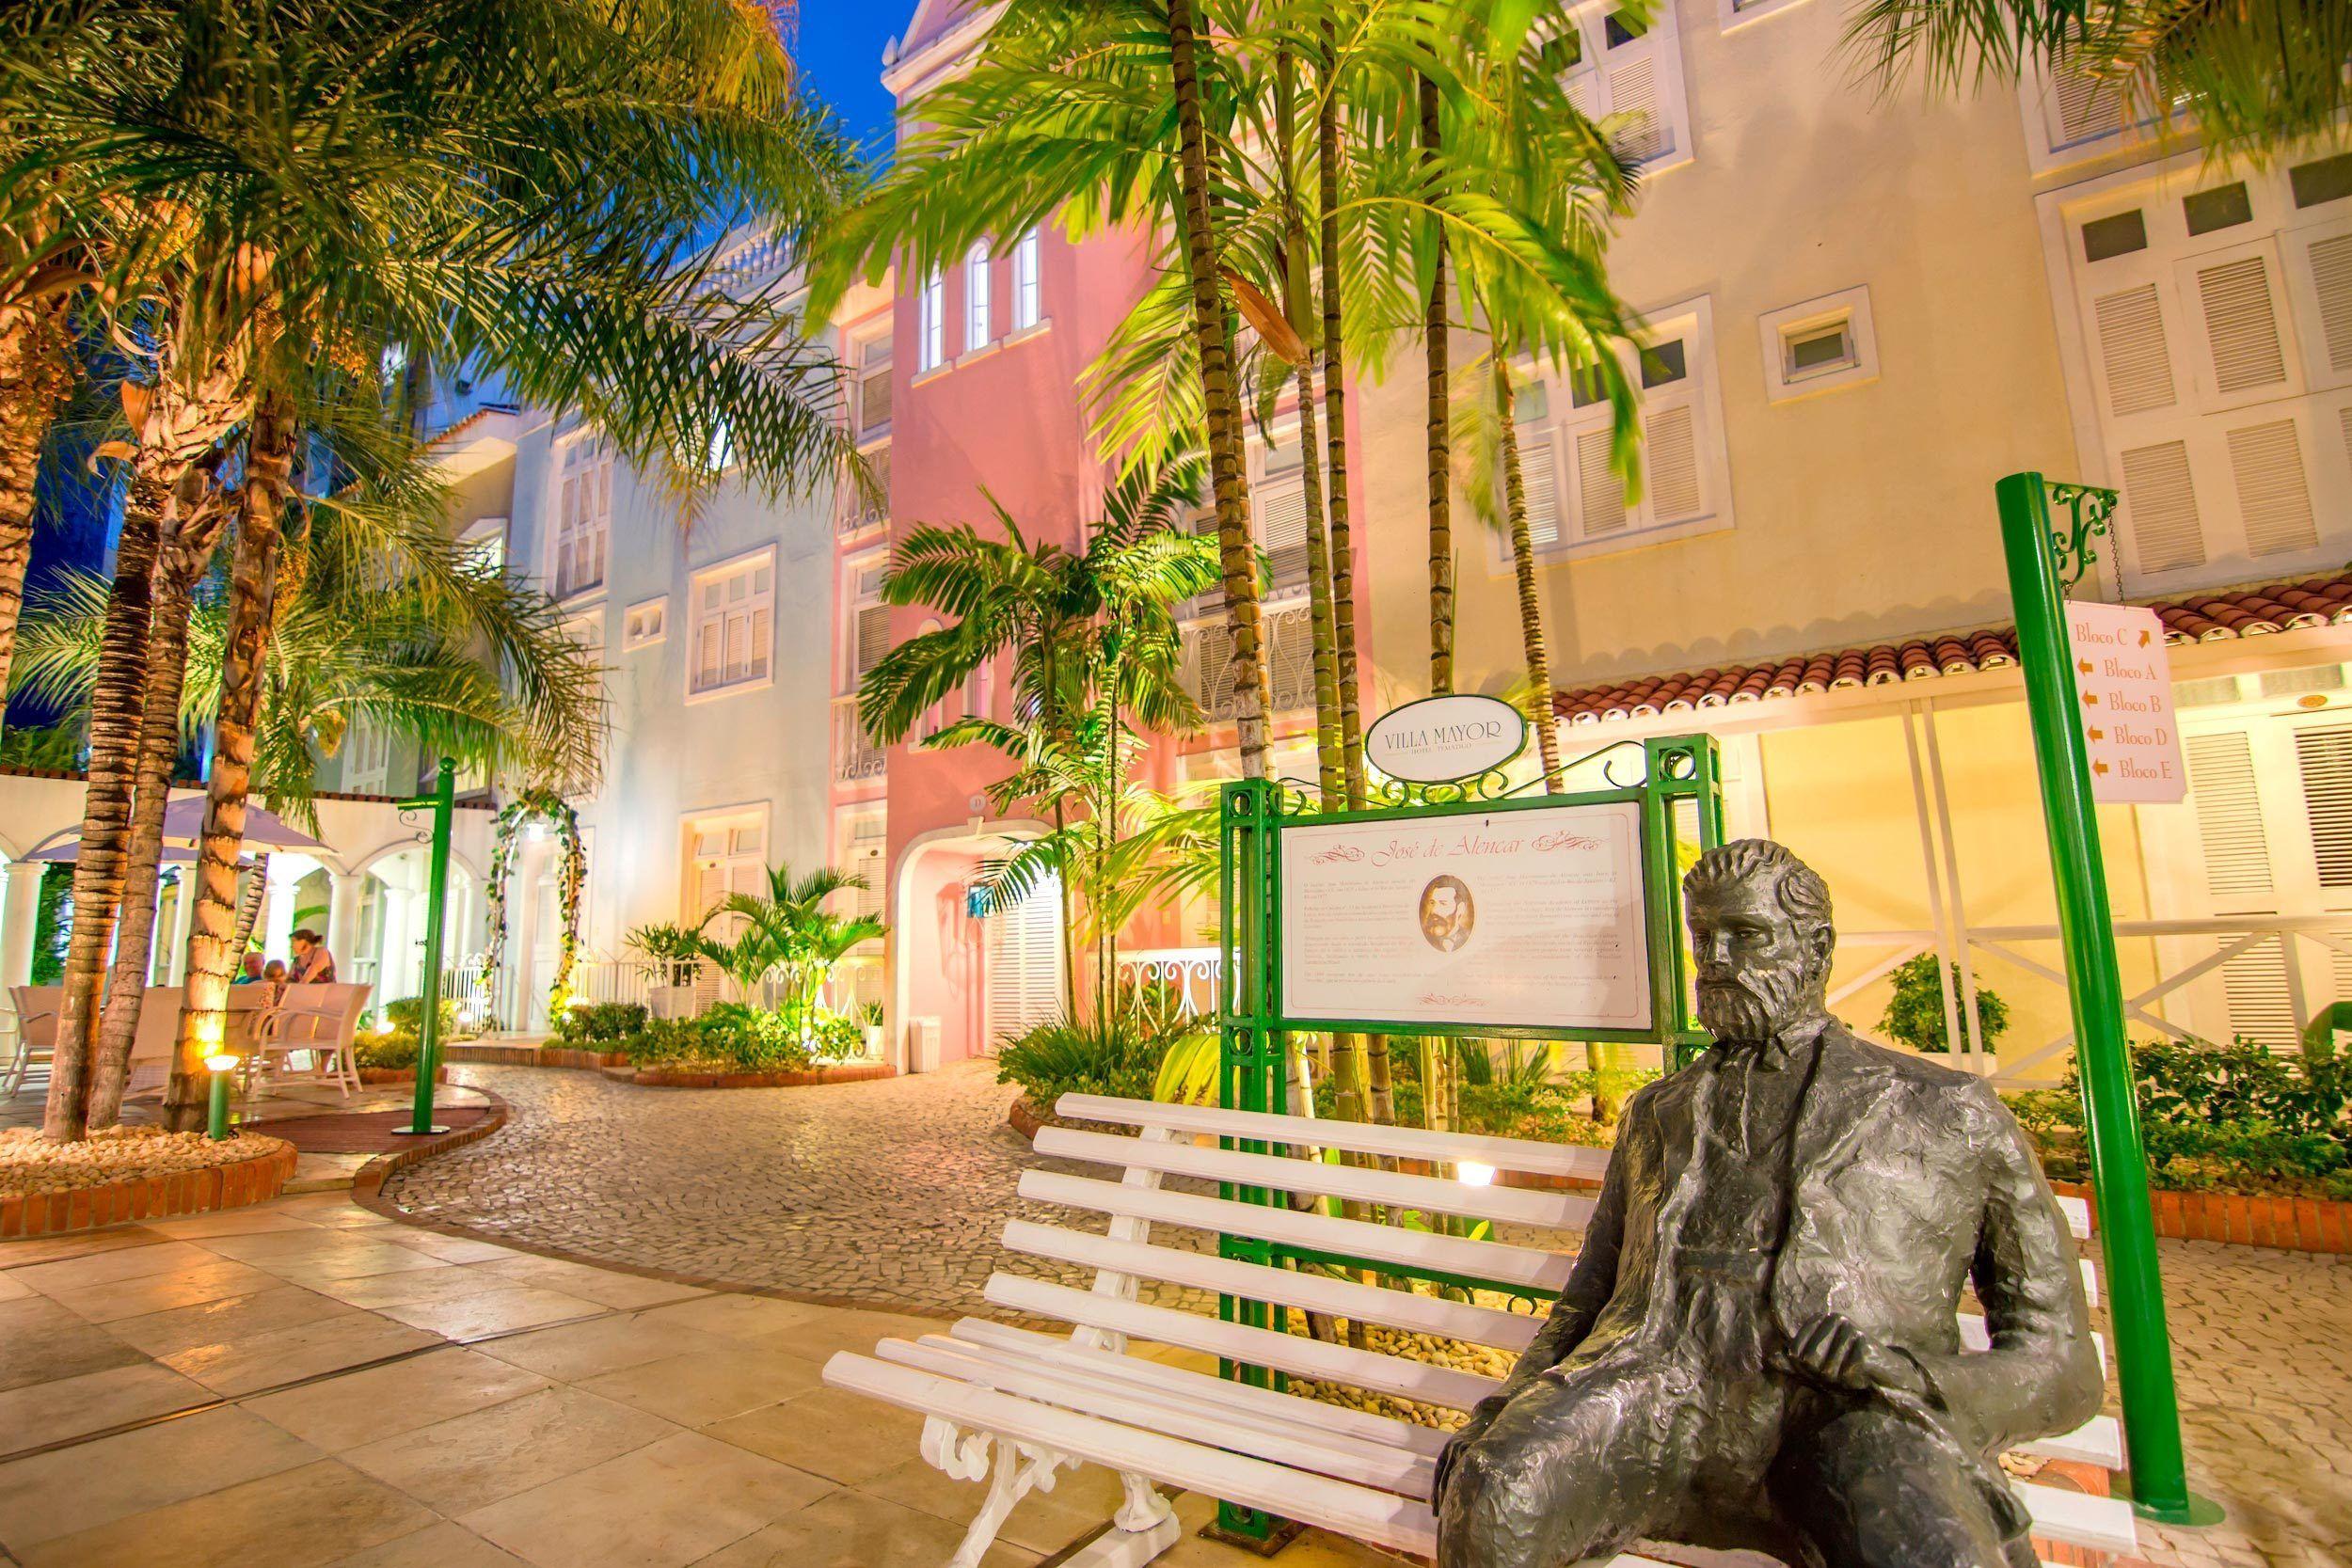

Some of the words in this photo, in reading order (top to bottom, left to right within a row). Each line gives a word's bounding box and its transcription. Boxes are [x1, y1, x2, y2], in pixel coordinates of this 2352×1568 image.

[2074, 624, 2114, 644] Bloco
[2117, 627, 2128, 646] C
[2104, 657, 2141, 680] Bloco
[2145, 664, 2158, 680] A
[2108, 691, 2147, 713] Bloco
[2152, 695, 2161, 713] B
[1385, 730, 1429, 750] VILLA
[1434, 721, 1502, 744] MAYOR
[2114, 725, 2152, 746] Bloco
[2154, 728, 2167, 746] D
[2119, 759, 2157, 780] Bloco
[2160, 761, 2172, 780] E
[1371, 840, 1419, 867] José
[1422, 835, 1442, 858] de
[1447, 834, 1525, 857] Alencar
